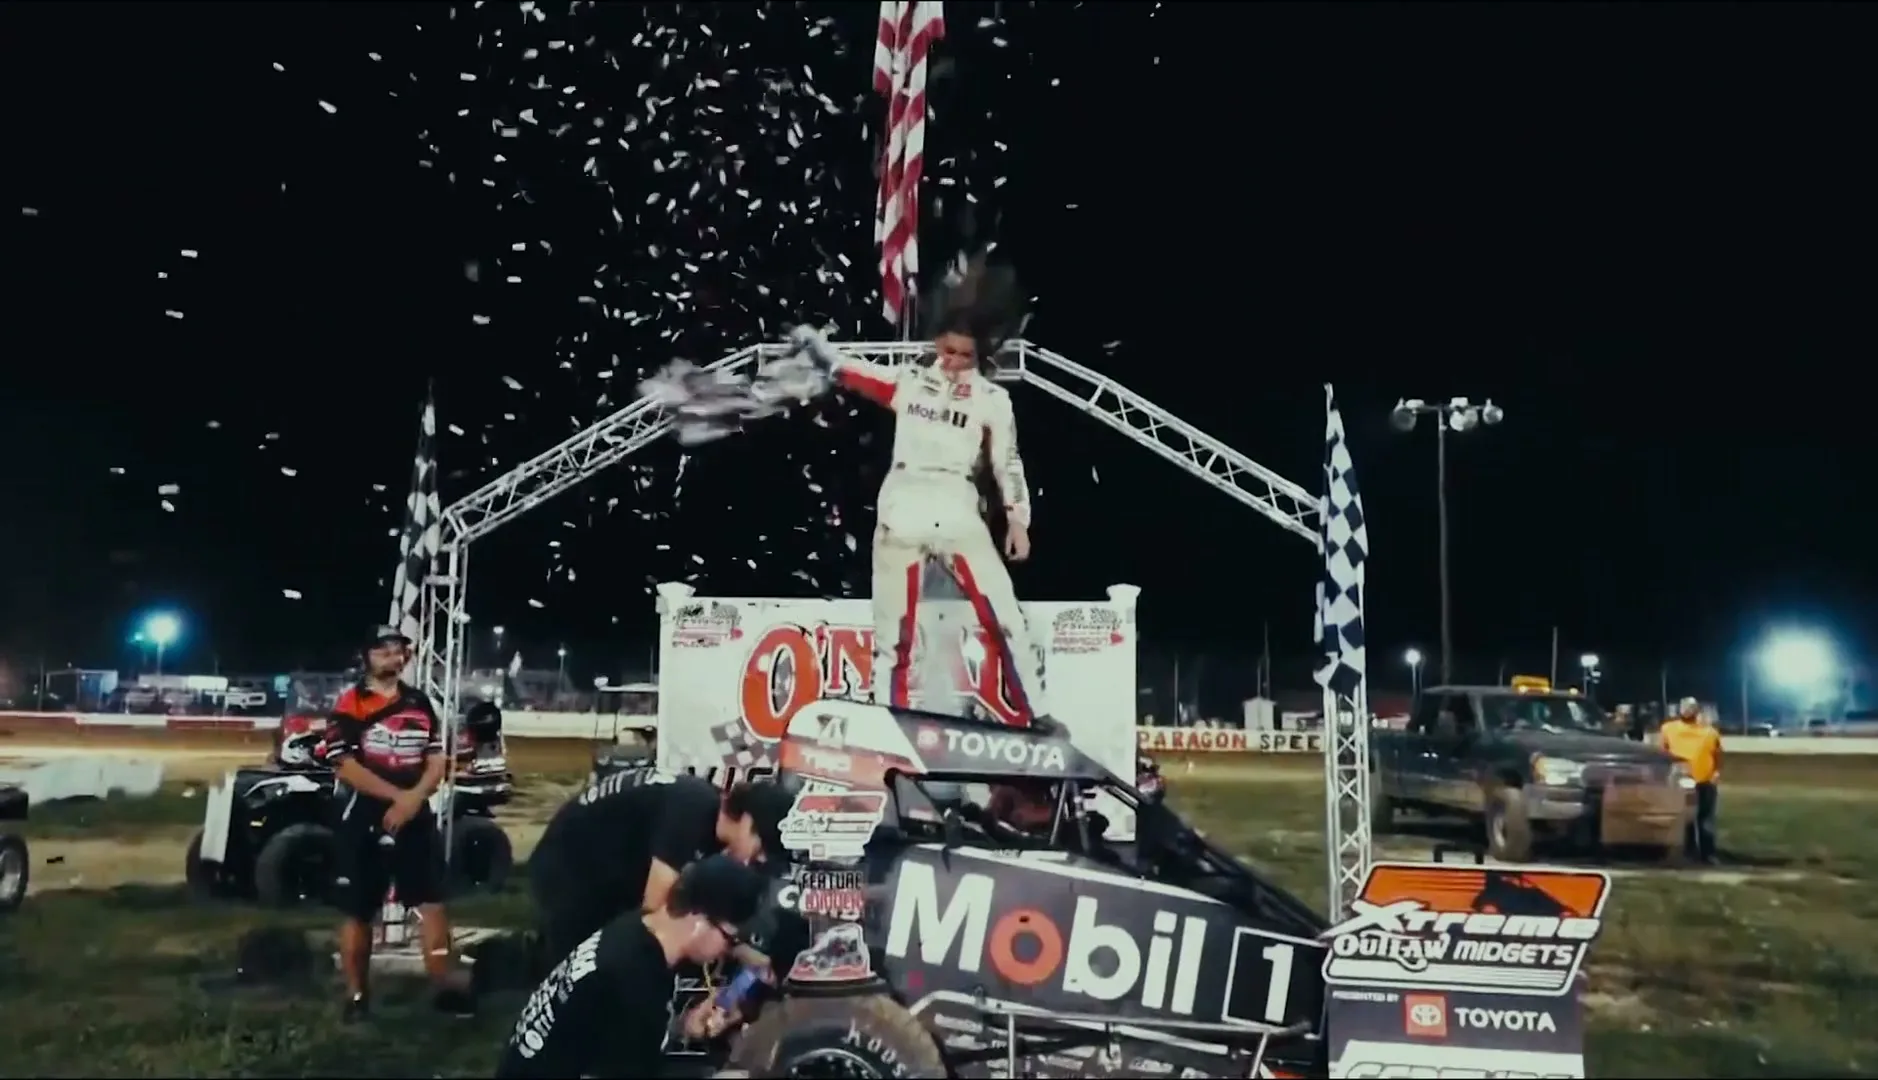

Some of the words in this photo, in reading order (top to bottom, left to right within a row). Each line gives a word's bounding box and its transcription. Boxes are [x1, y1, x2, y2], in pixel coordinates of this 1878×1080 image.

[943, 728, 1066, 771] TOYOTA
[1137, 730, 1247, 749] PARAGON
[1260, 734, 1321, 750] SPEE
[885, 859, 1207, 1016] Mobil
[1262, 942, 1295, 1023] 1
[1452, 940, 1573, 966] MIDGETS
[1453, 1007, 1556, 1033] TOYOTA
